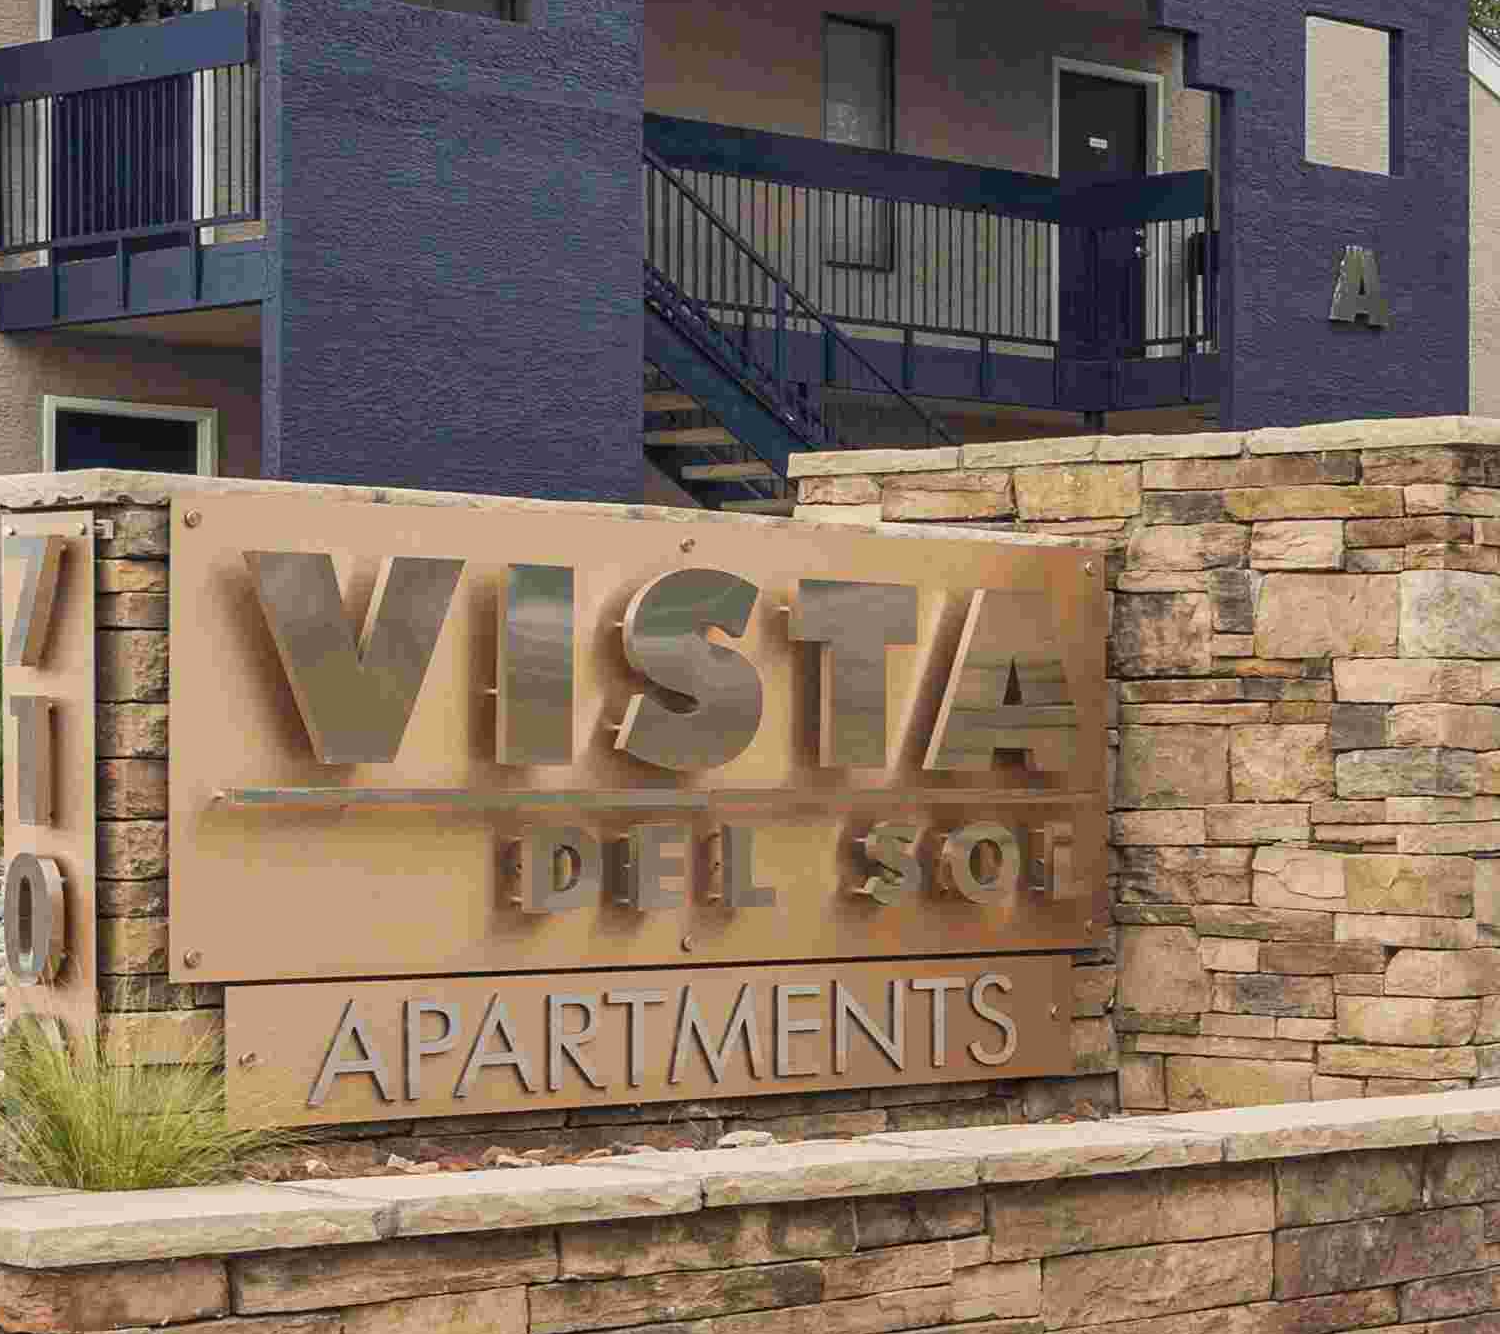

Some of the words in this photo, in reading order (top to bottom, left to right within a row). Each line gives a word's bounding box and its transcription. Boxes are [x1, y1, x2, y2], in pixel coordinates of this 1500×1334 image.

[1329, 244, 1388, 329] A
[242, 549, 1080, 773] VISTA
[3, 534, 67, 986] 710
[520, 823, 777, 914] DEL
[860, 819, 1092, 908] SOL
[307, 973, 1018, 1108] APARTMENTS
